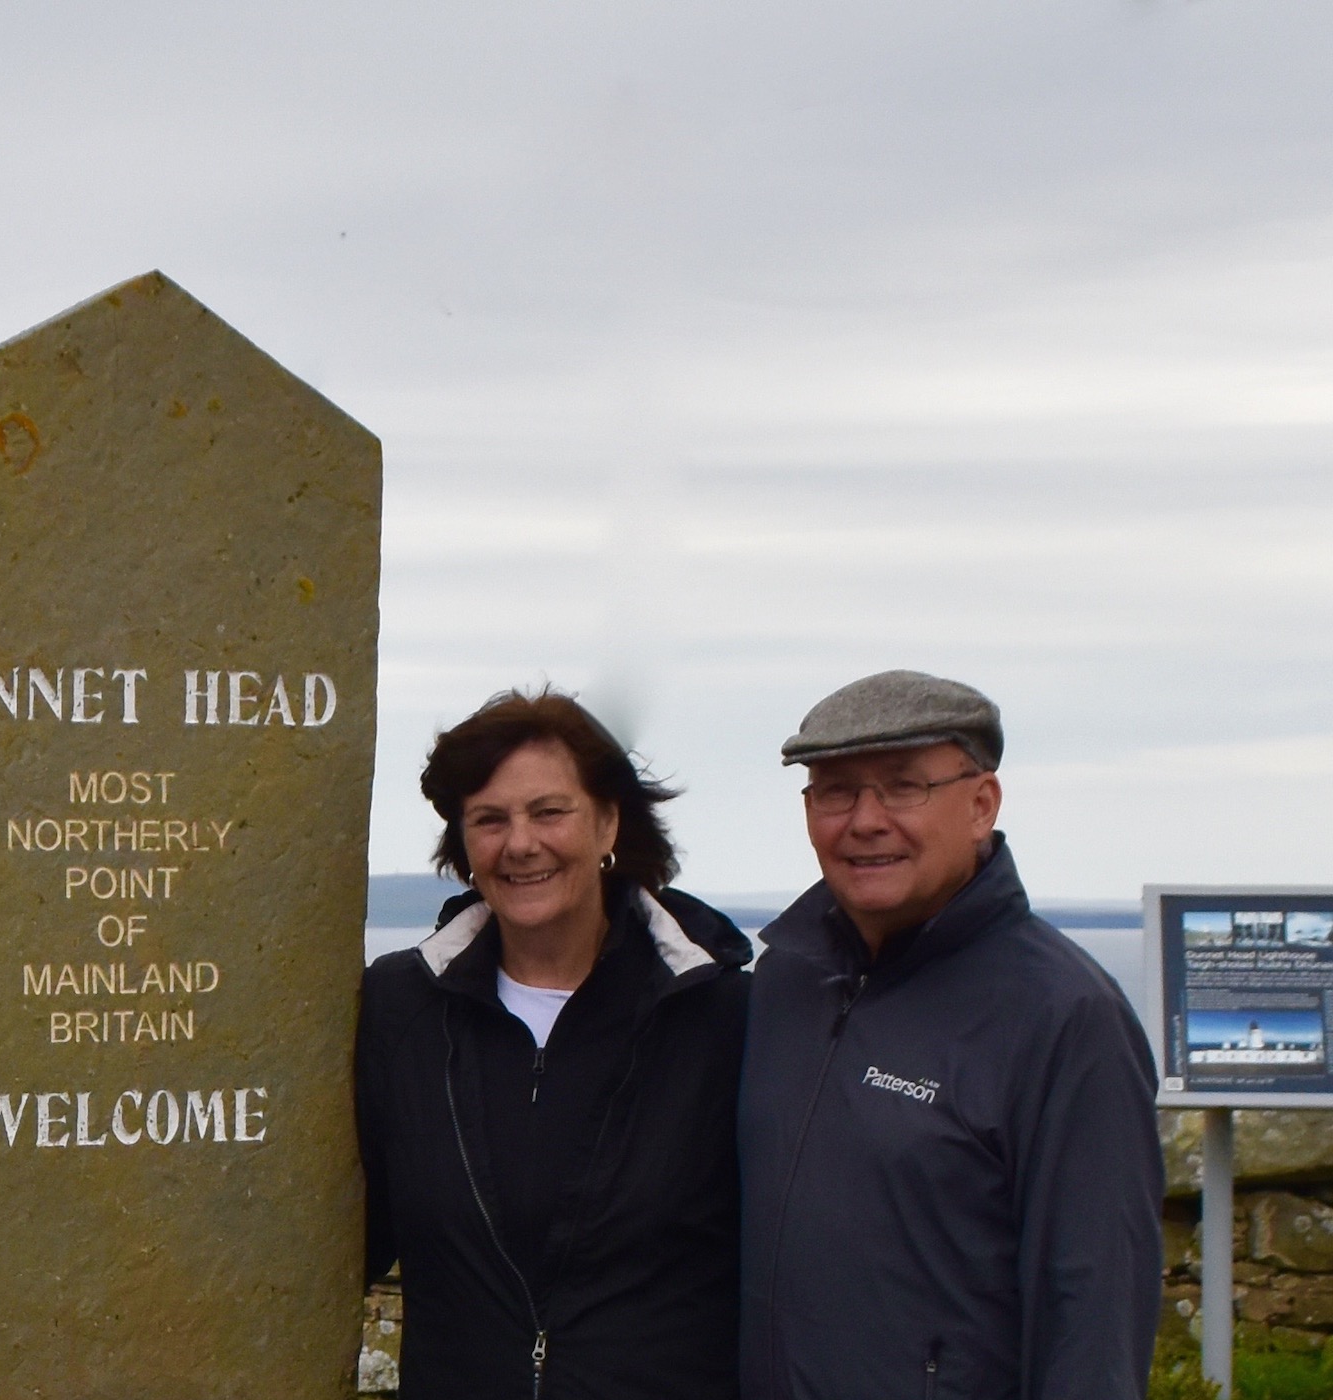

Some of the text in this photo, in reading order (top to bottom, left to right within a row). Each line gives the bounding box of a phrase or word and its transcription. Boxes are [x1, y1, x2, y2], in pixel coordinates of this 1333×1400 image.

[184, 669, 338, 727] HEAD
[69, 771, 175, 804] MOST
[7, 819, 233, 851] NORTHERLY
[65, 867, 179, 899] POINT
[96, 914, 147, 947] OF
[22, 962, 220, 995] MAINLAND
[49, 1011, 196, 1044] BRITAIN
[861, 1065, 936, 1105] Patterson
